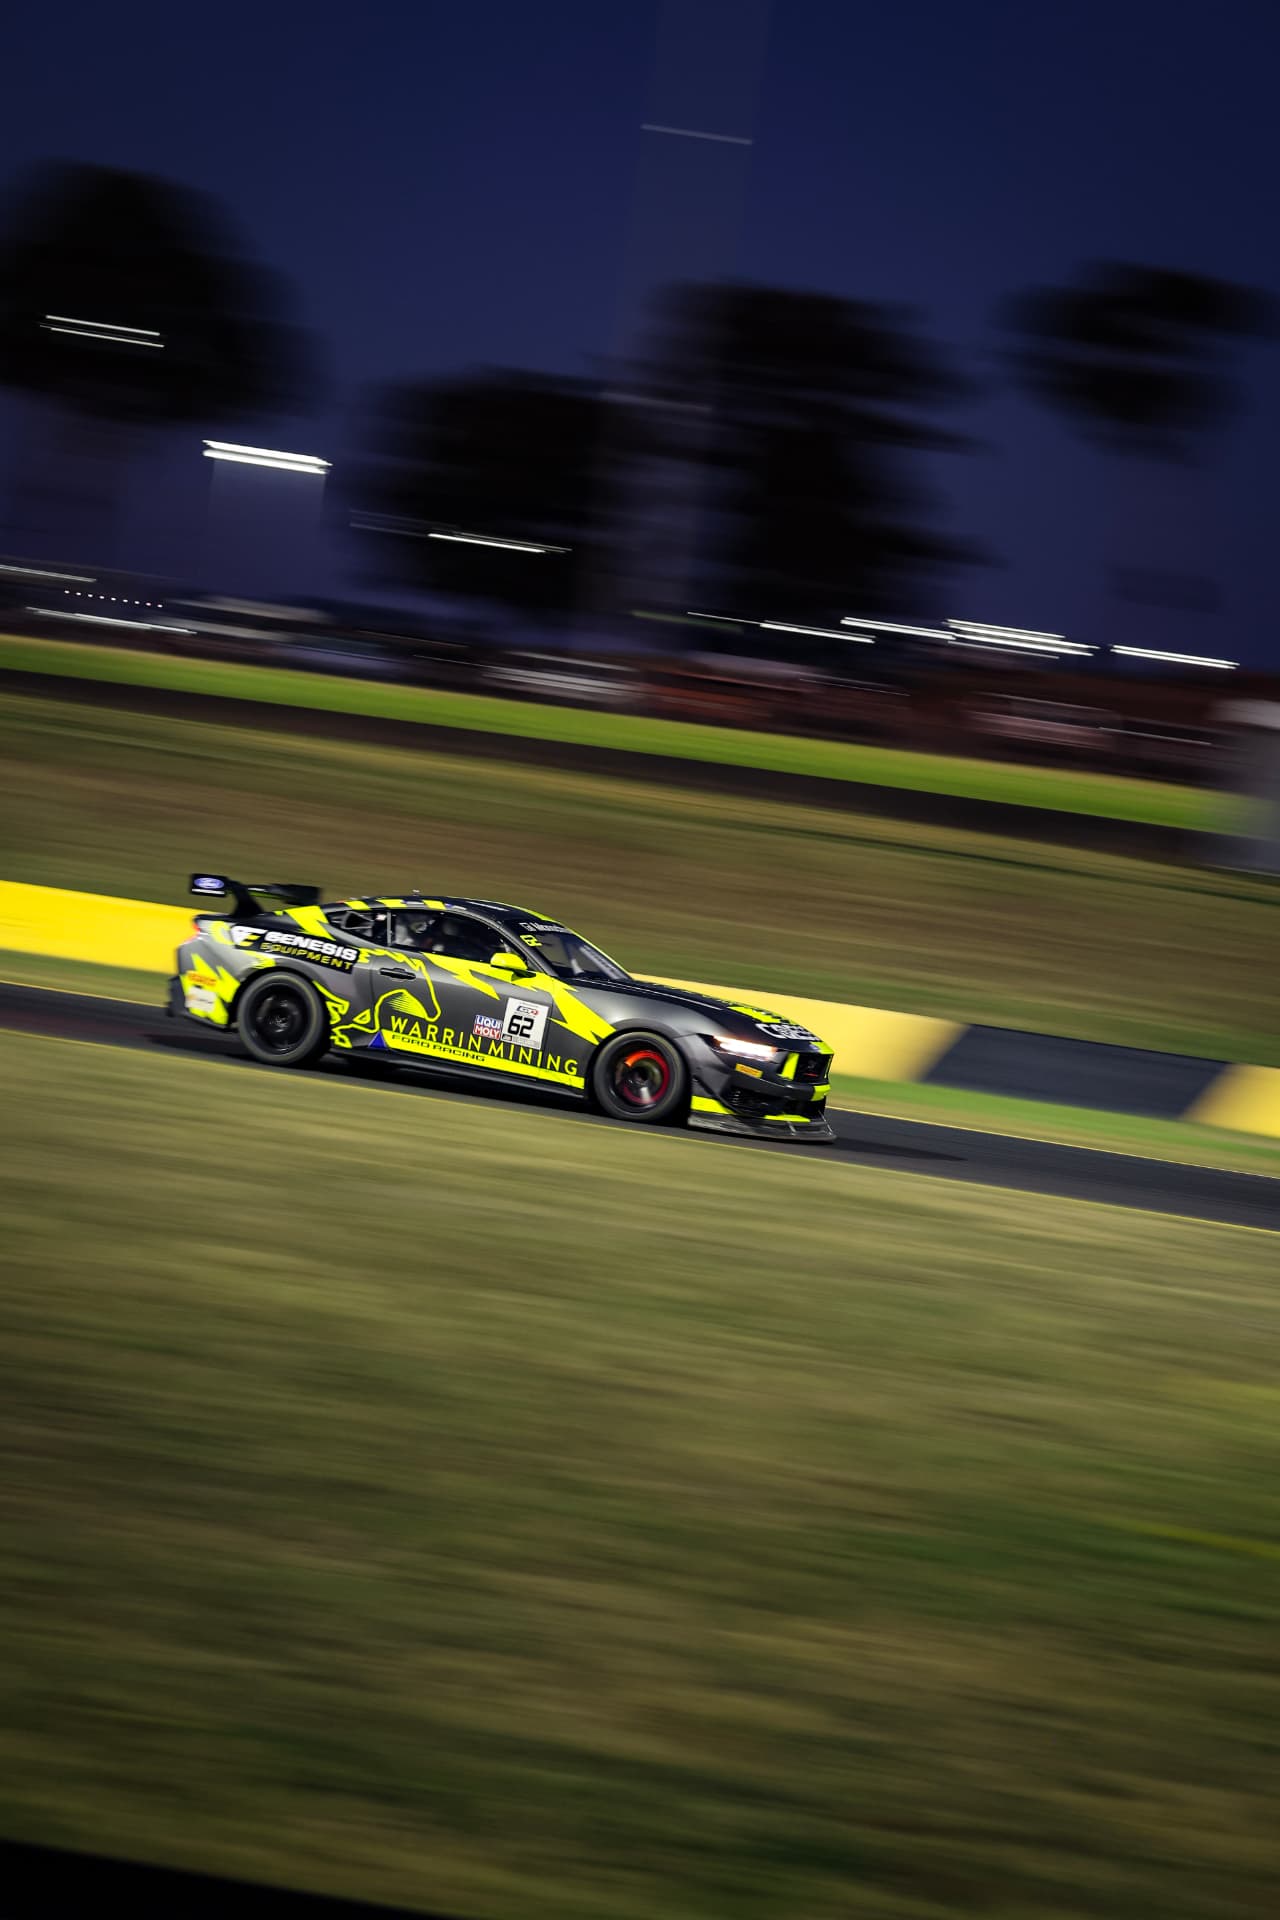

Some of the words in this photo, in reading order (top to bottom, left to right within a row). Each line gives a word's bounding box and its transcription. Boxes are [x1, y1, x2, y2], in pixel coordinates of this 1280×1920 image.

[260, 942, 353, 970] EQUIPMENT
[264, 931, 358, 961] GENESIS
[474, 1025, 501, 1041] MOLY
[508, 1014, 535, 1039] 62
[391, 1015, 482, 1052] WARRIN
[488, 1039, 578, 1076] MINING
[392, 1034, 430, 1049] FORD
[432, 1044, 486, 1062] RACING
